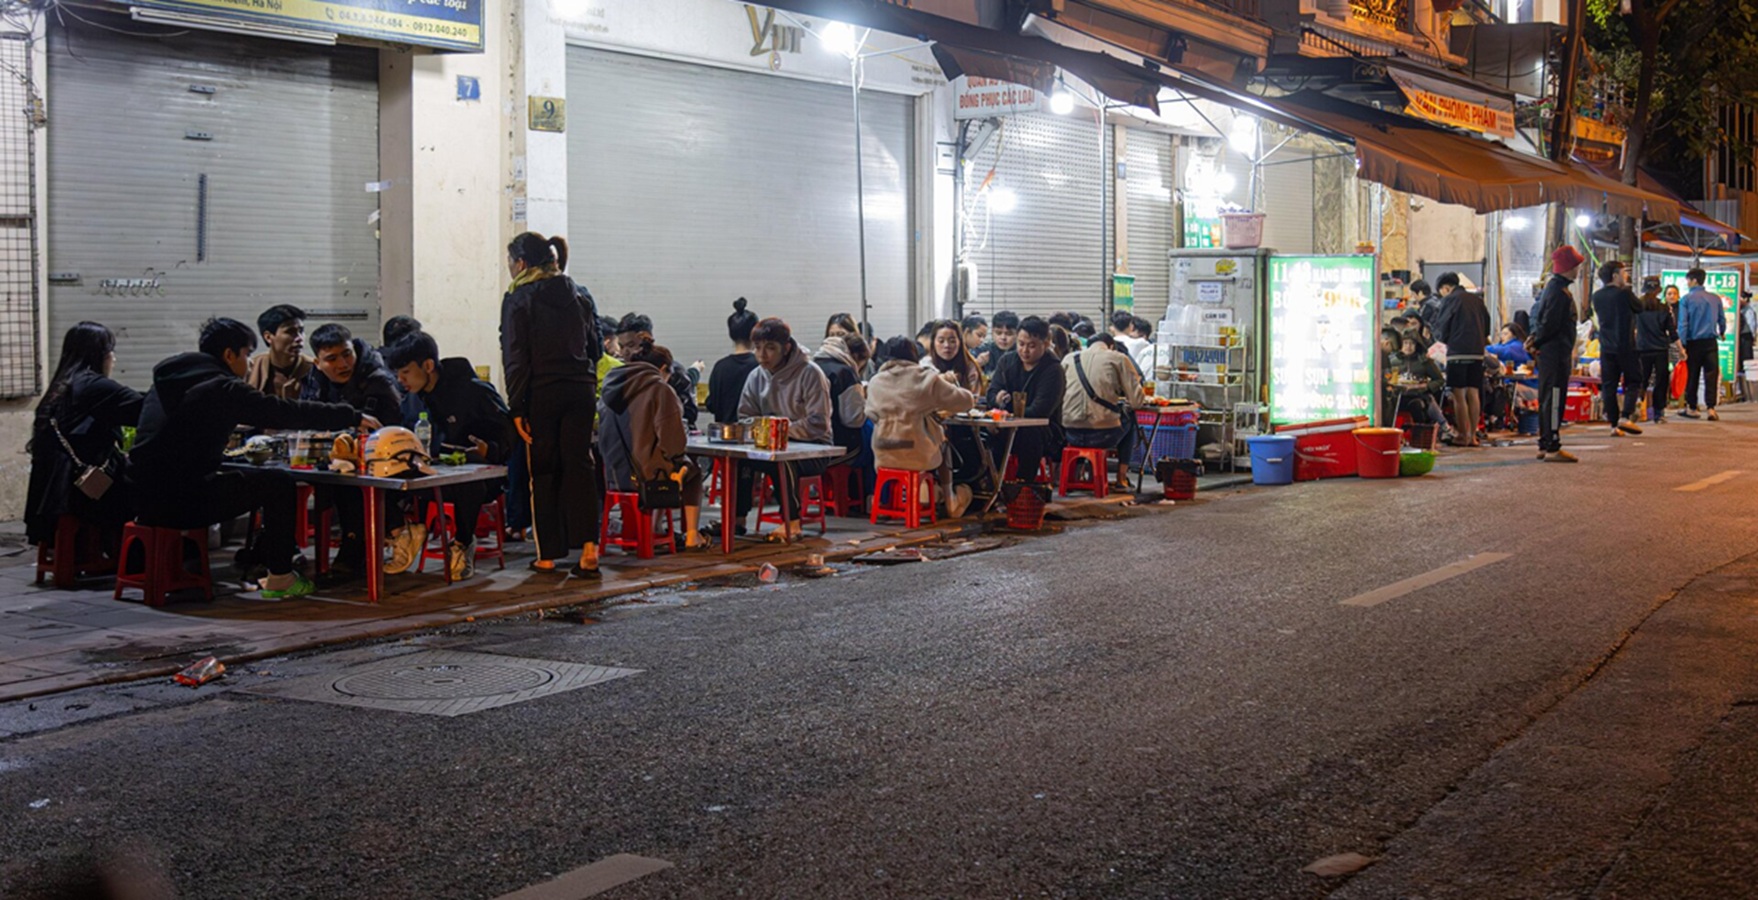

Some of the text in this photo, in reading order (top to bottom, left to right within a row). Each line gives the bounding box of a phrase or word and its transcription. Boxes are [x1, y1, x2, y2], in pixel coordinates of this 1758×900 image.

[413, 21, 467, 37] 0912.040.240
[464, 81, 473, 97] 7
[543, 99, 556, 119] 9
[981, 93, 1000, 109] PHỤC
